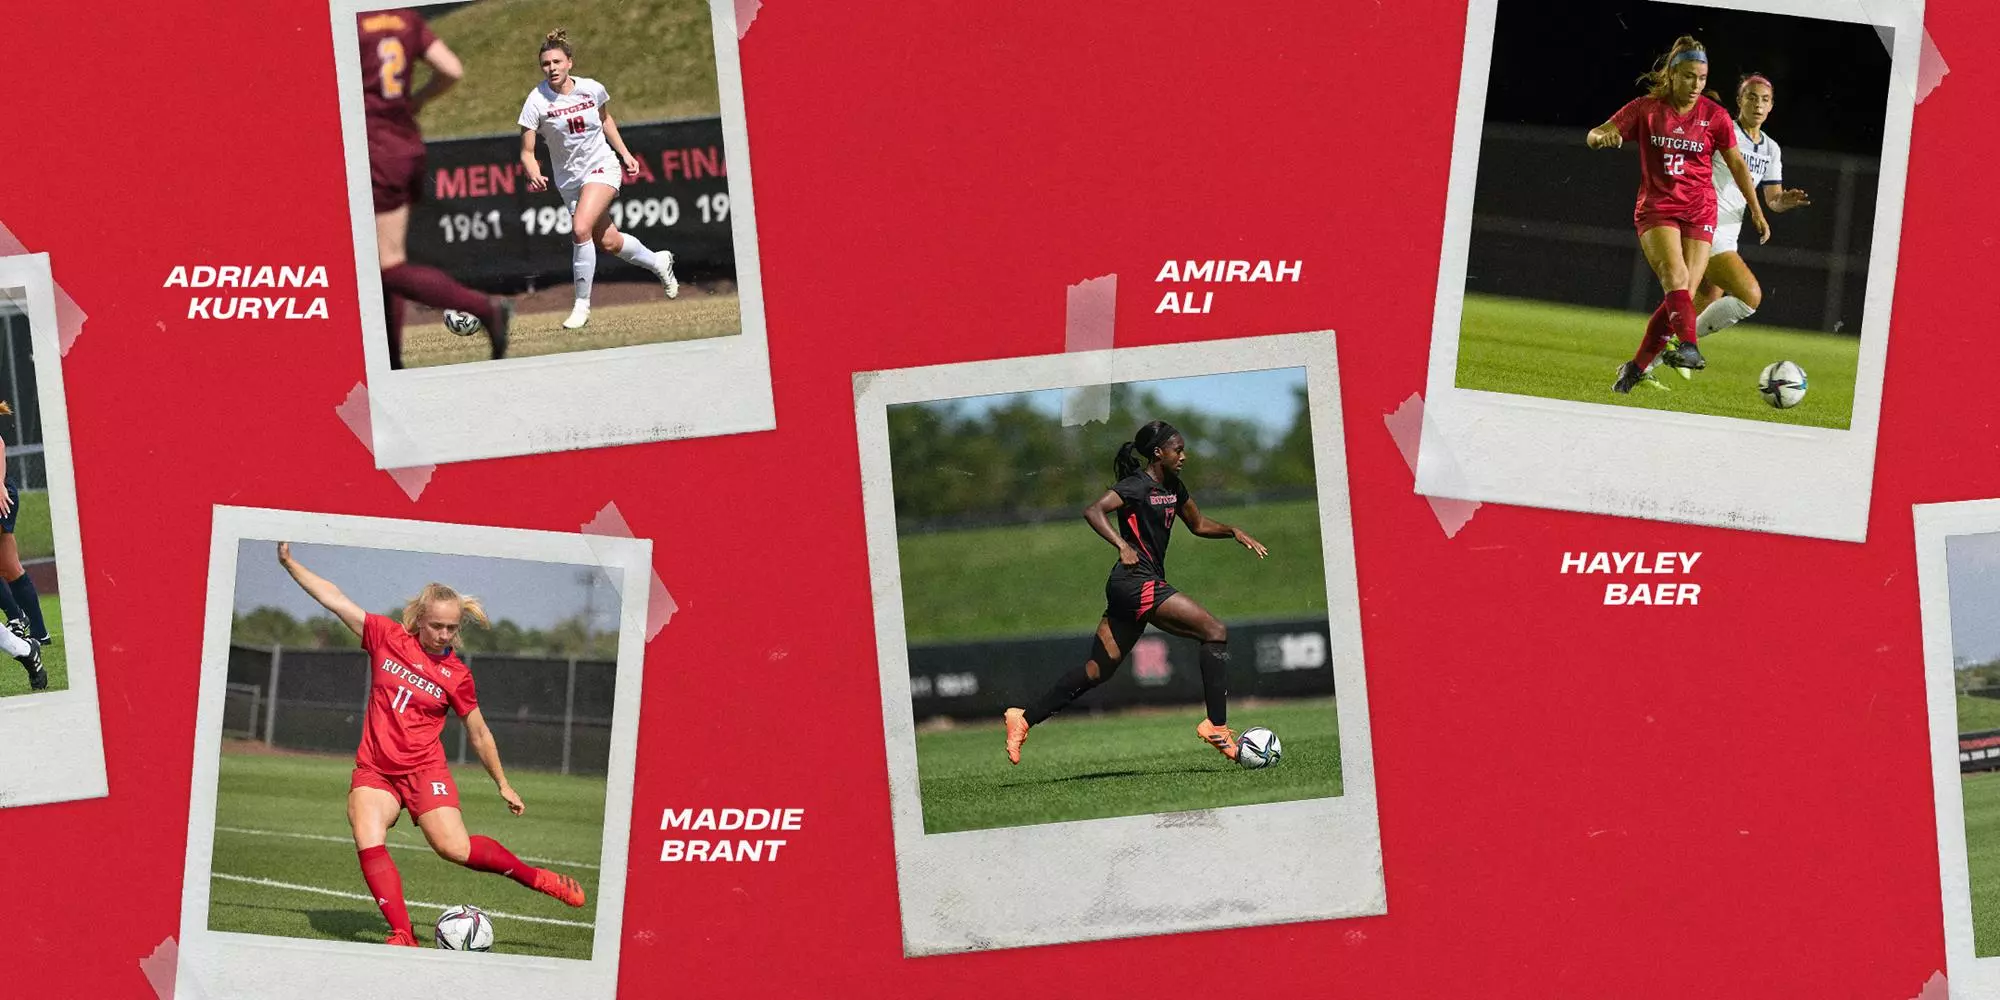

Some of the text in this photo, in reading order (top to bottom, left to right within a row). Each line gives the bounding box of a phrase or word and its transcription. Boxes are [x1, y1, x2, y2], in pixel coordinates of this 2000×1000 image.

[377, 37, 406, 99] 2
[547, 100, 595, 118] RUTGERS
[1651, 135, 1705, 153] RUTGERS
[1663, 153, 1685, 175] 22
[439, 209, 503, 243] 1961
[521, 205, 573, 235] 198
[609, 196, 680, 230] 1990
[382, 658, 443, 699] RUTGERS
[391, 685, 413, 714] 11
[430, 781, 449, 796] R
